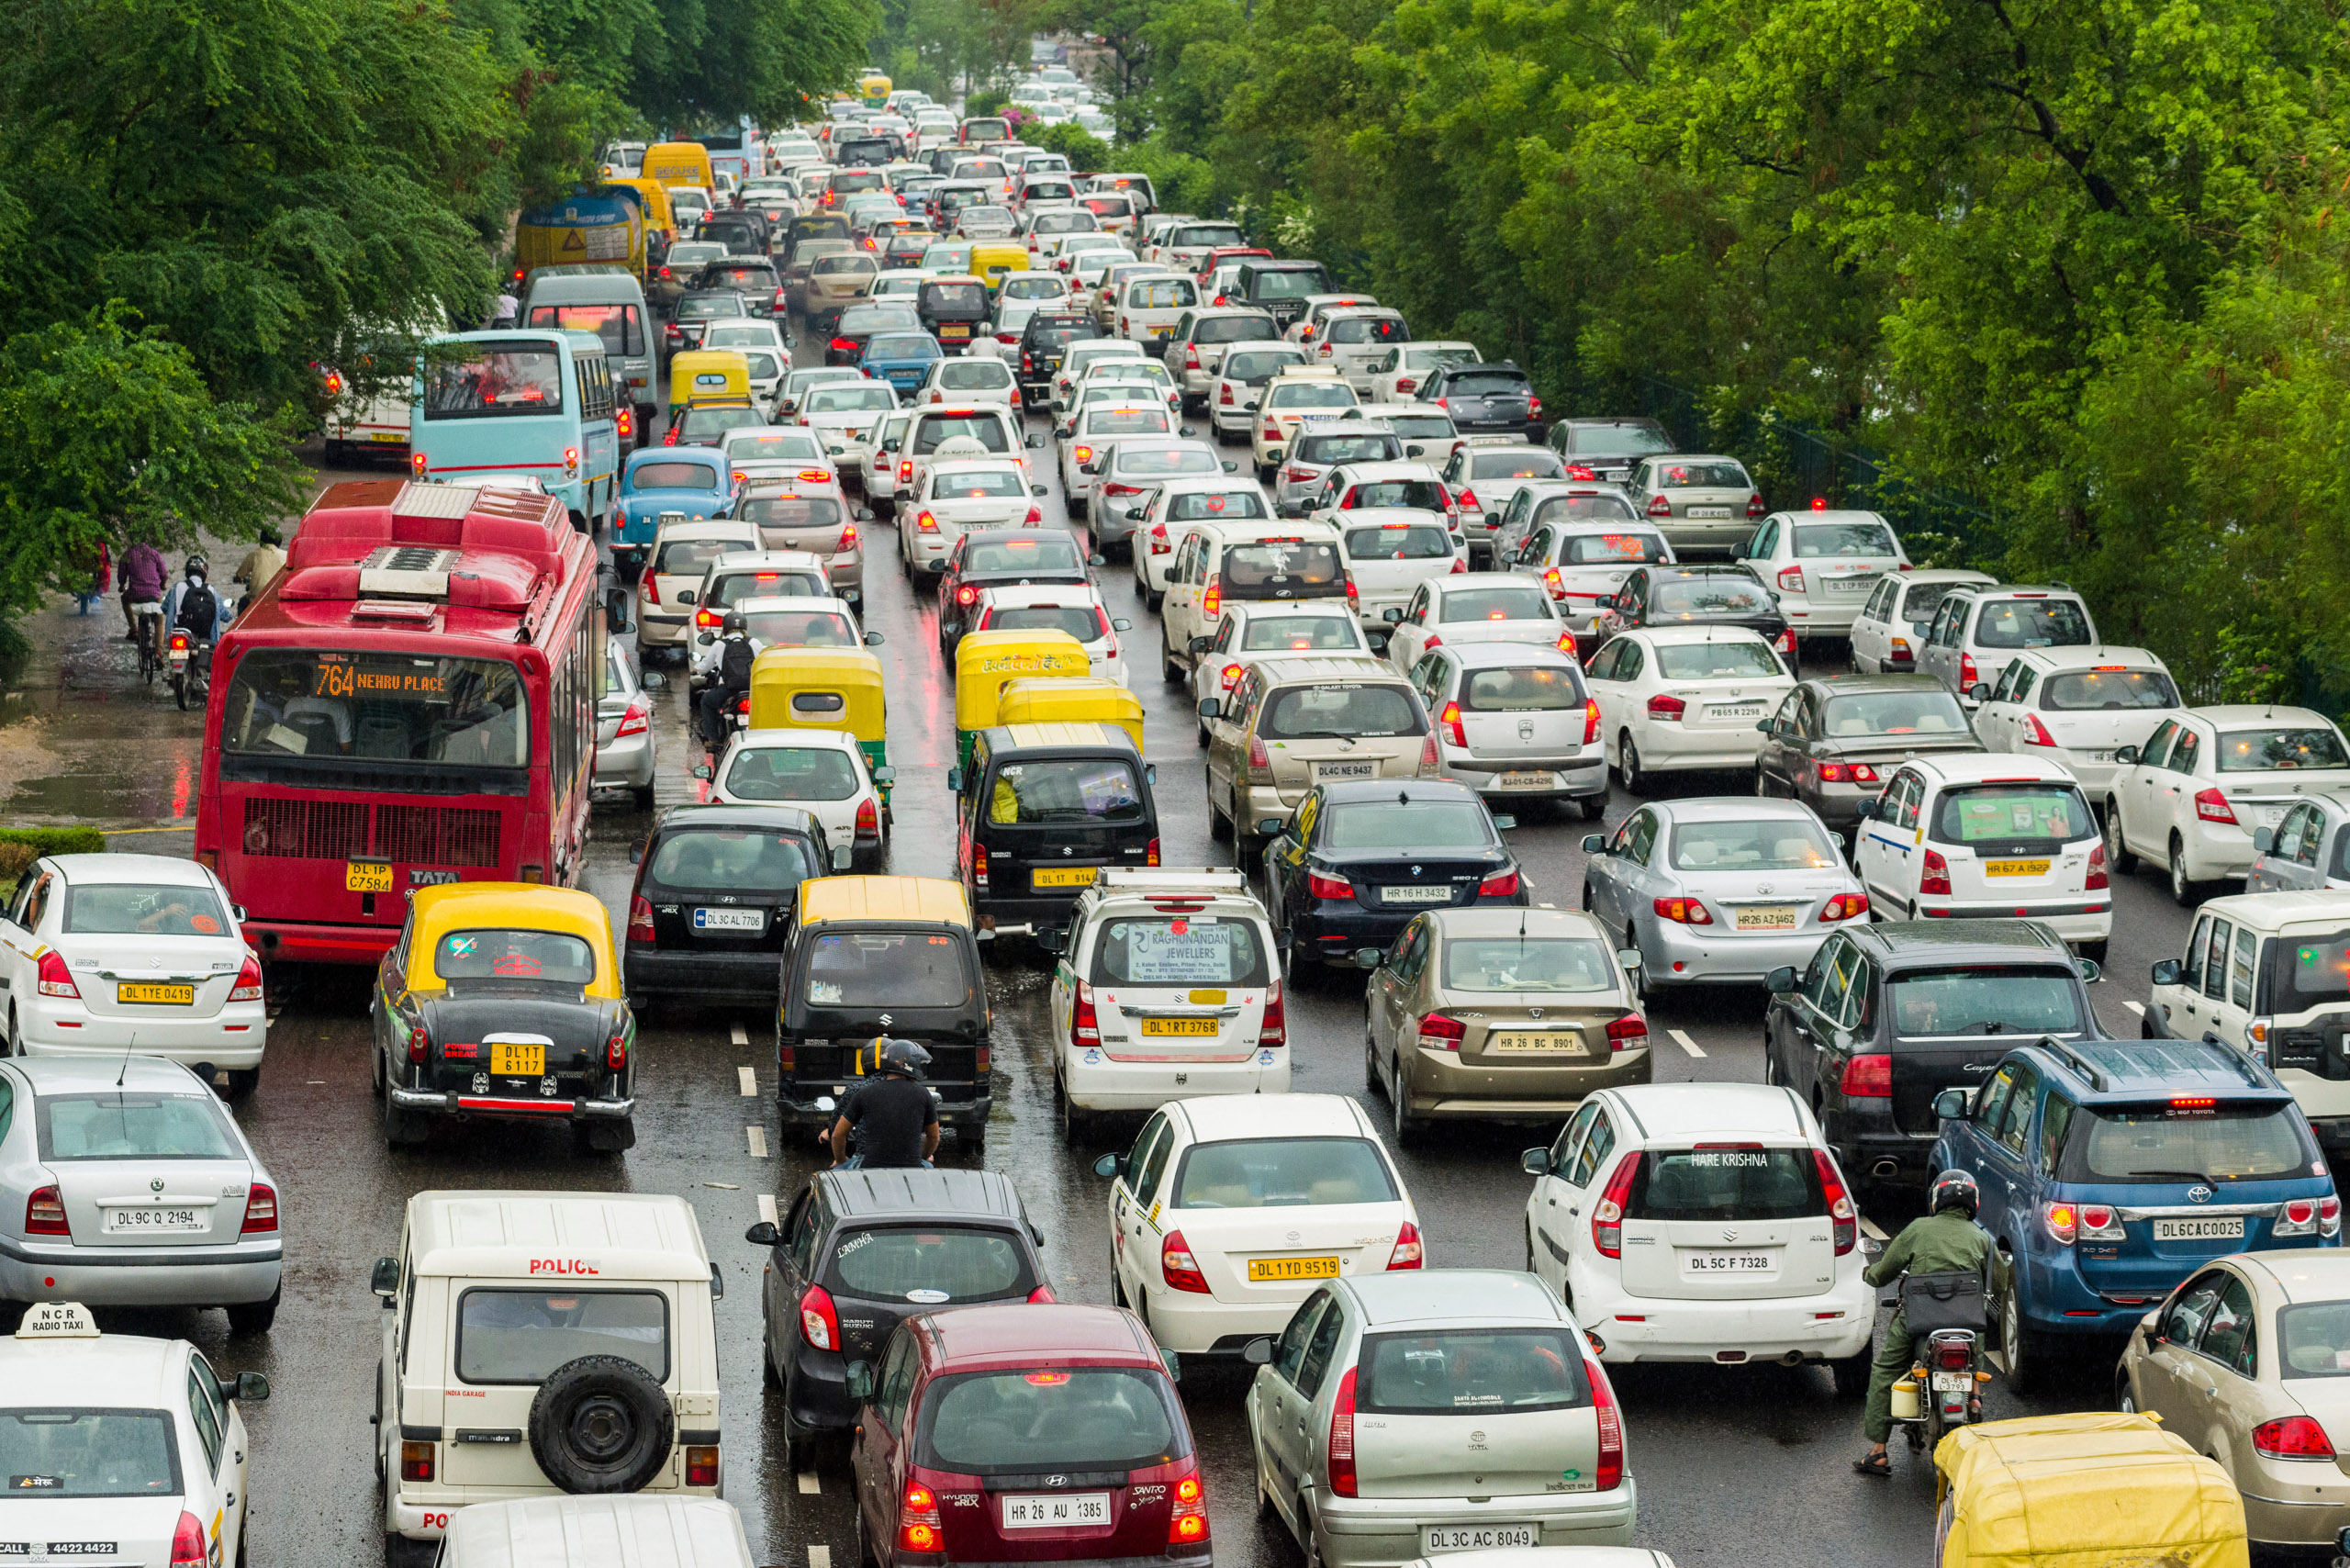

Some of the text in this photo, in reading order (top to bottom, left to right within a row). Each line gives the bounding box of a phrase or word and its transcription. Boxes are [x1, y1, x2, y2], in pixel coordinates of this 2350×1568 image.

[317, 664, 445, 697] 764 NEHRU PLACE
[1003, 767, 1023, 777] NCR
[1353, 766, 1372, 775] 9437
[411, 870, 460, 884] TATA
[1387, 889, 1446, 898] HR 16 H 3432
[707, 913, 760, 926] DL 3C AL 7706
[1763, 915, 1774, 924] AZ
[1776, 914, 1795, 924] 1462
[1152, 934, 1228, 945] RAGHUNANDAN
[1167, 947, 1215, 959] JEWELLERS
[127, 987, 140, 999] DL
[165, 989, 191, 1001] 0419
[1150, 1022, 1163, 1033] DL
[1190, 1021, 1216, 1033] 3768
[1501, 1038, 1573, 1047] HR 26 BC 8901
[444, 1050, 478, 1058] BREAK
[505, 1060, 540, 1072] 6117
[1964, 1064, 1995, 1073] Caye
[1691, 1153, 1768, 1167] HARE KRISHNA
[154, 1212, 162, 1224] Q
[167, 1211, 194, 1224] 2194
[2162, 1221, 2243, 1238] DL6CAC0025
[837, 1232, 874, 1259] LAMHA
[530, 1259, 599, 1274] POLICE
[1258, 1263, 1274, 1277] DL
[1305, 1260, 1337, 1275] 9519
[1692, 1258, 1768, 1270] DL 5C F 7328
[33, 1321, 84, 1331] RADIO TAXI
[1133, 1485, 1167, 1495] SANTRO
[1012, 1502, 1102, 1520] HR 26 AU 1385
[1431, 1530, 1529, 1548] DL 3C AC 8049
[0, 1543, 114, 1553] CALL 4422 4422
